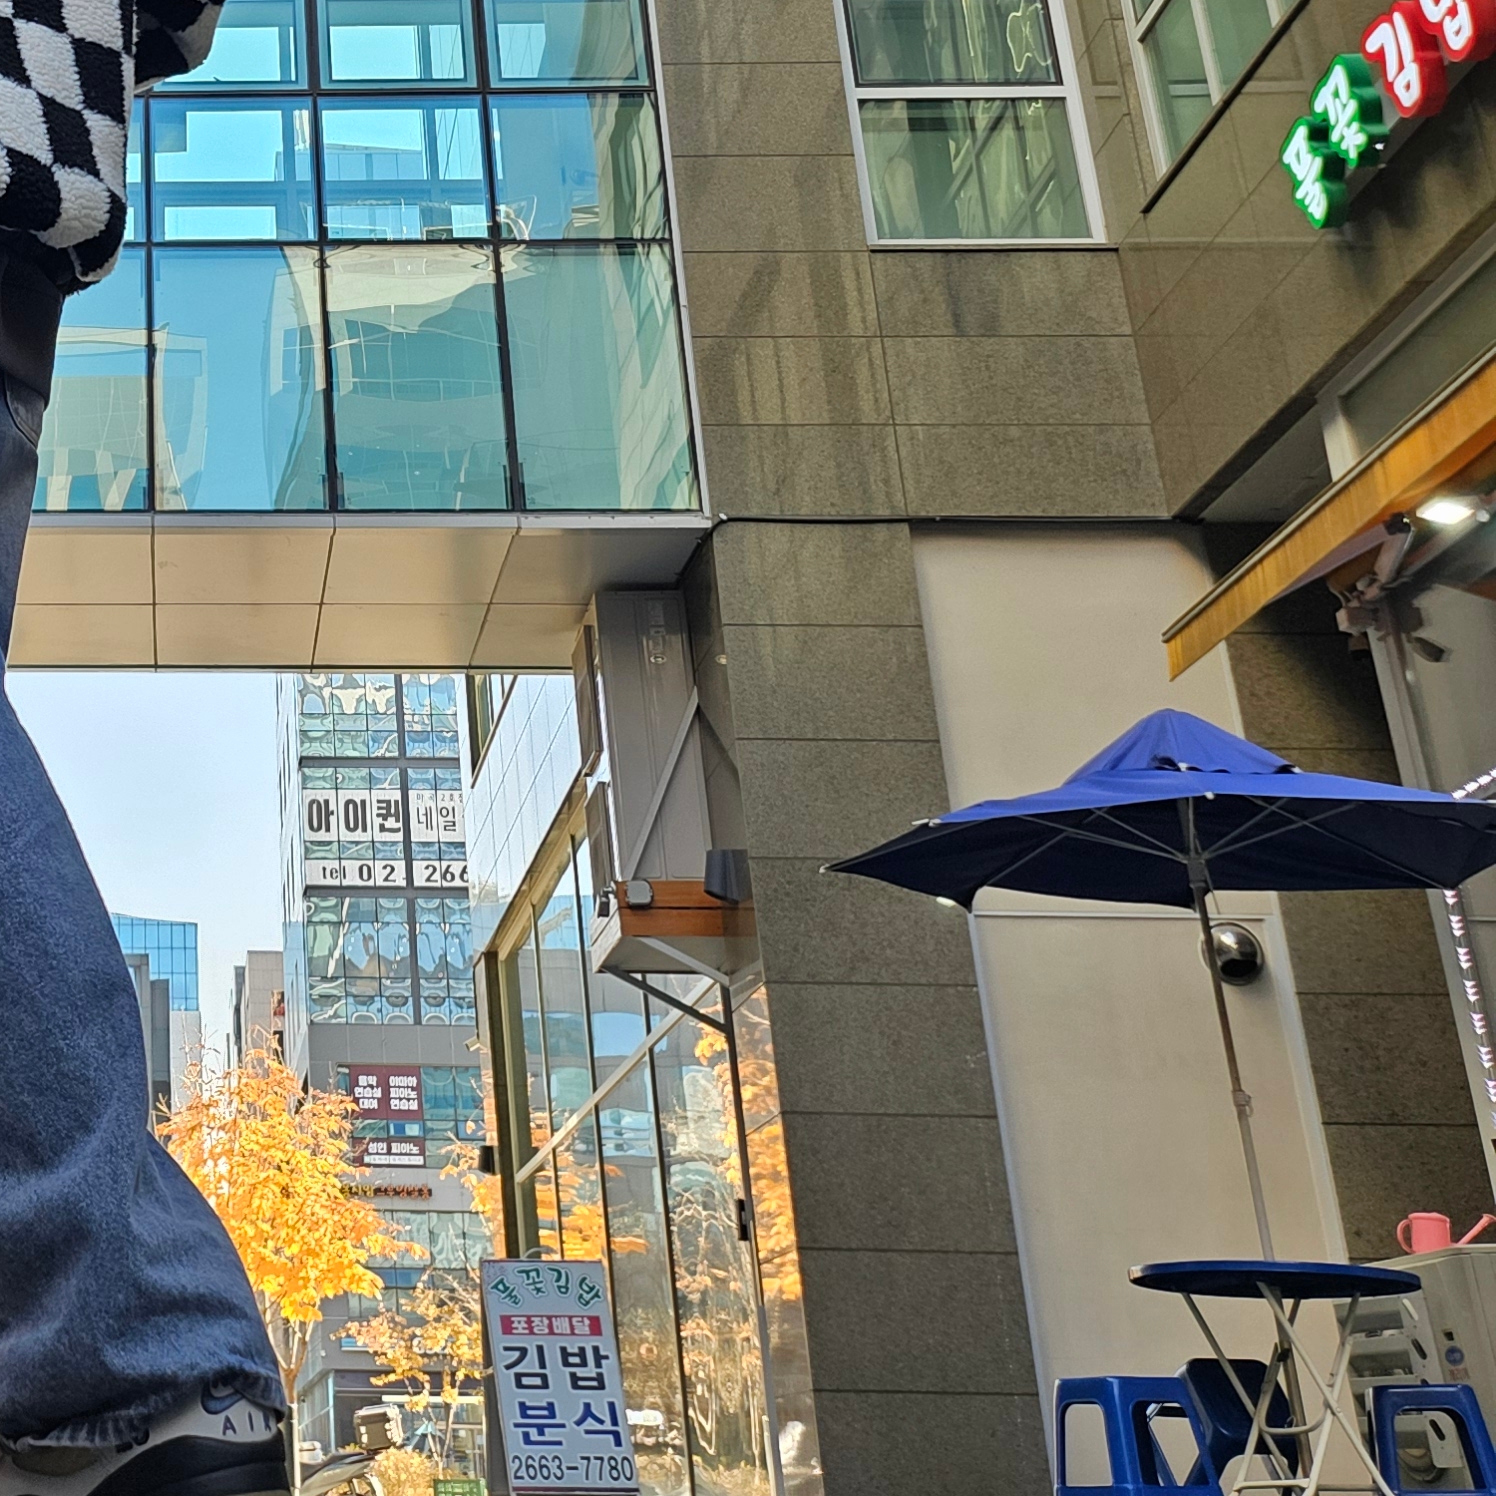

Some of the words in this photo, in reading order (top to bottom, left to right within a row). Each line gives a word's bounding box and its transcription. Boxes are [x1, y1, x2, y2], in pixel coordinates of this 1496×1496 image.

[307, 797, 402, 834] 아이퀸
[321, 865, 347, 881] tel
[390, 1087, 418, 1099] 피아노
[368, 1141, 388, 1154] 성인
[391, 1142, 420, 1154] 피아노
[510, 1316, 591, 1335] 포장배달
[502, 1344, 610, 1391] 김밥
[513, 1401, 623, 1448] 분식
[511, 1455, 634, 1482] 2663-7780
